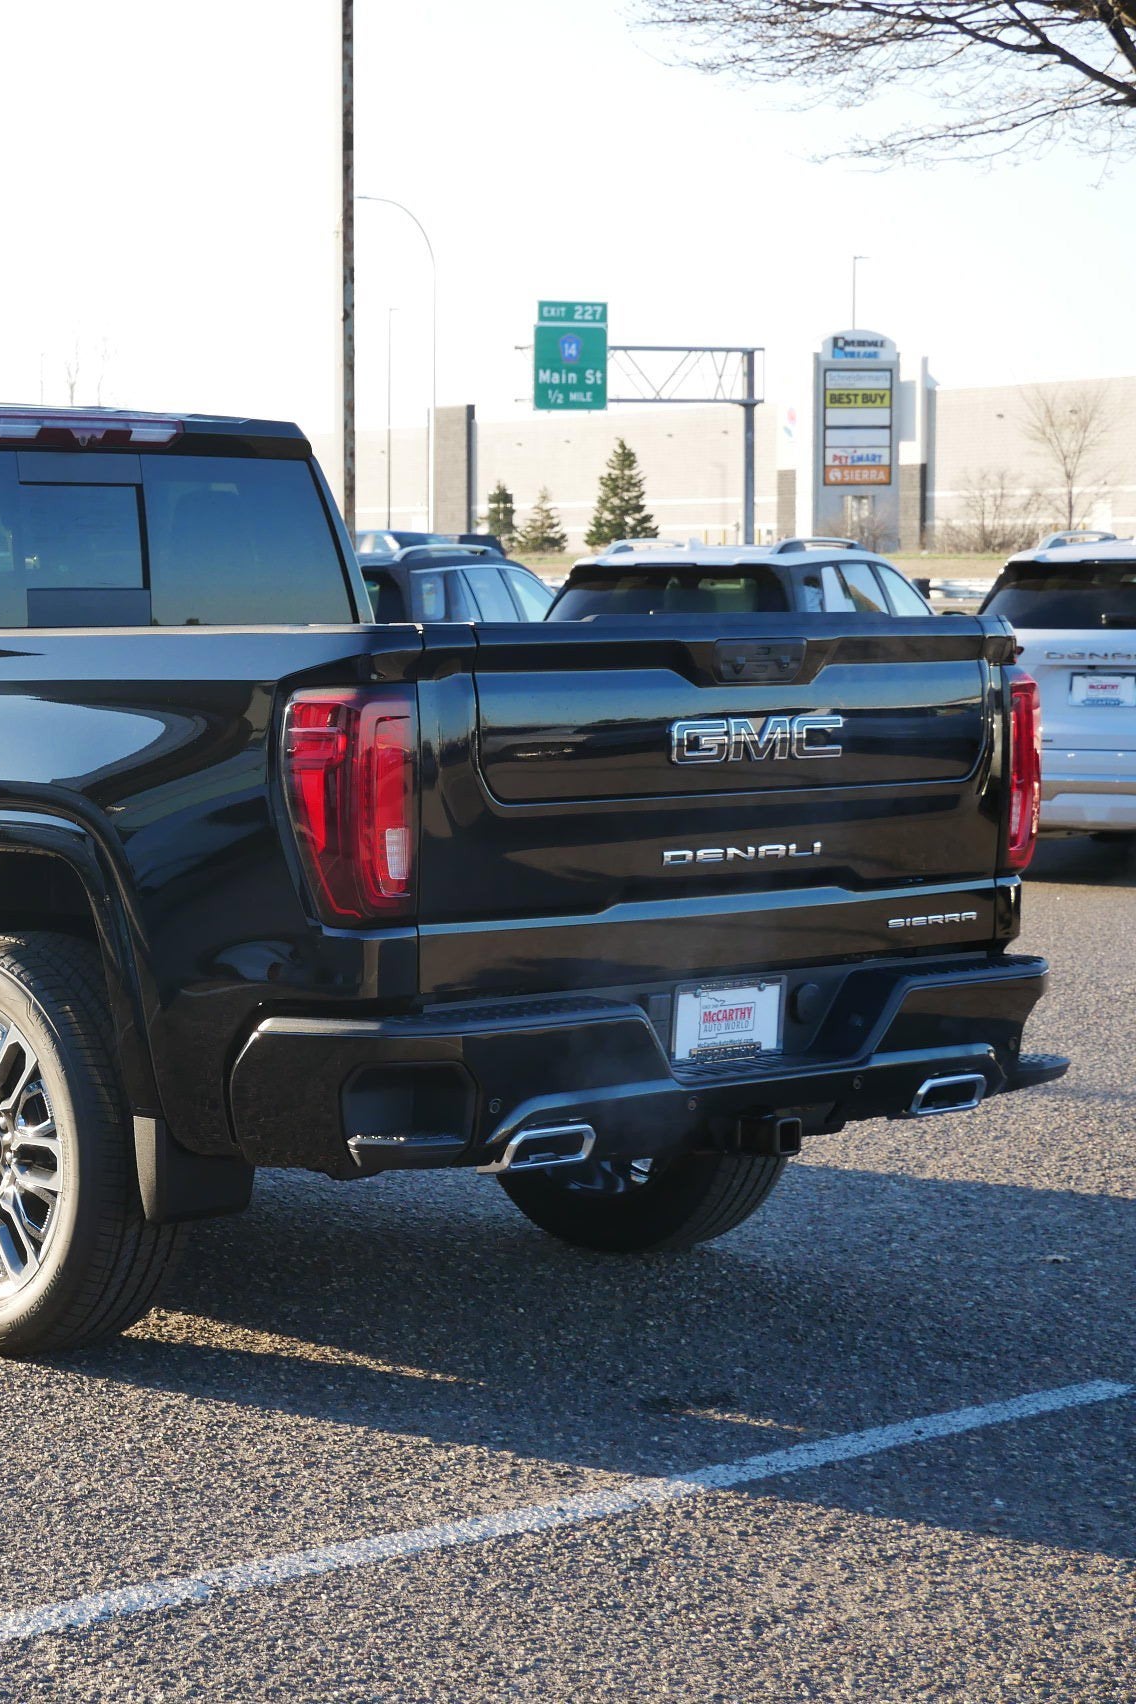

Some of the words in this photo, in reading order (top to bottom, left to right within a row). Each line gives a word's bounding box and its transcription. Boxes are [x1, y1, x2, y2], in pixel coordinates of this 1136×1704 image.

[543, 306, 566, 317] EXIT
[573, 305, 603, 320] 227
[564, 343, 577, 357] 14
[539, 369, 577, 385] Main
[585, 369, 603, 385] St
[569, 392, 593, 403] MILE
[830, 393, 859, 405] BEST
[862, 393, 886, 405] BUY
[842, 470, 886, 482] SIERRA
[1046, 651, 1136, 660] DENA
[670, 715, 844, 765] GMC
[663, 841, 823, 866] DENALI
[887, 911, 978, 928] SIERRA
[702, 1006, 753, 1024] McCARTHY
[704, 1022, 722, 1033] AUTO
[724, 1019, 750, 1031] WORLD
